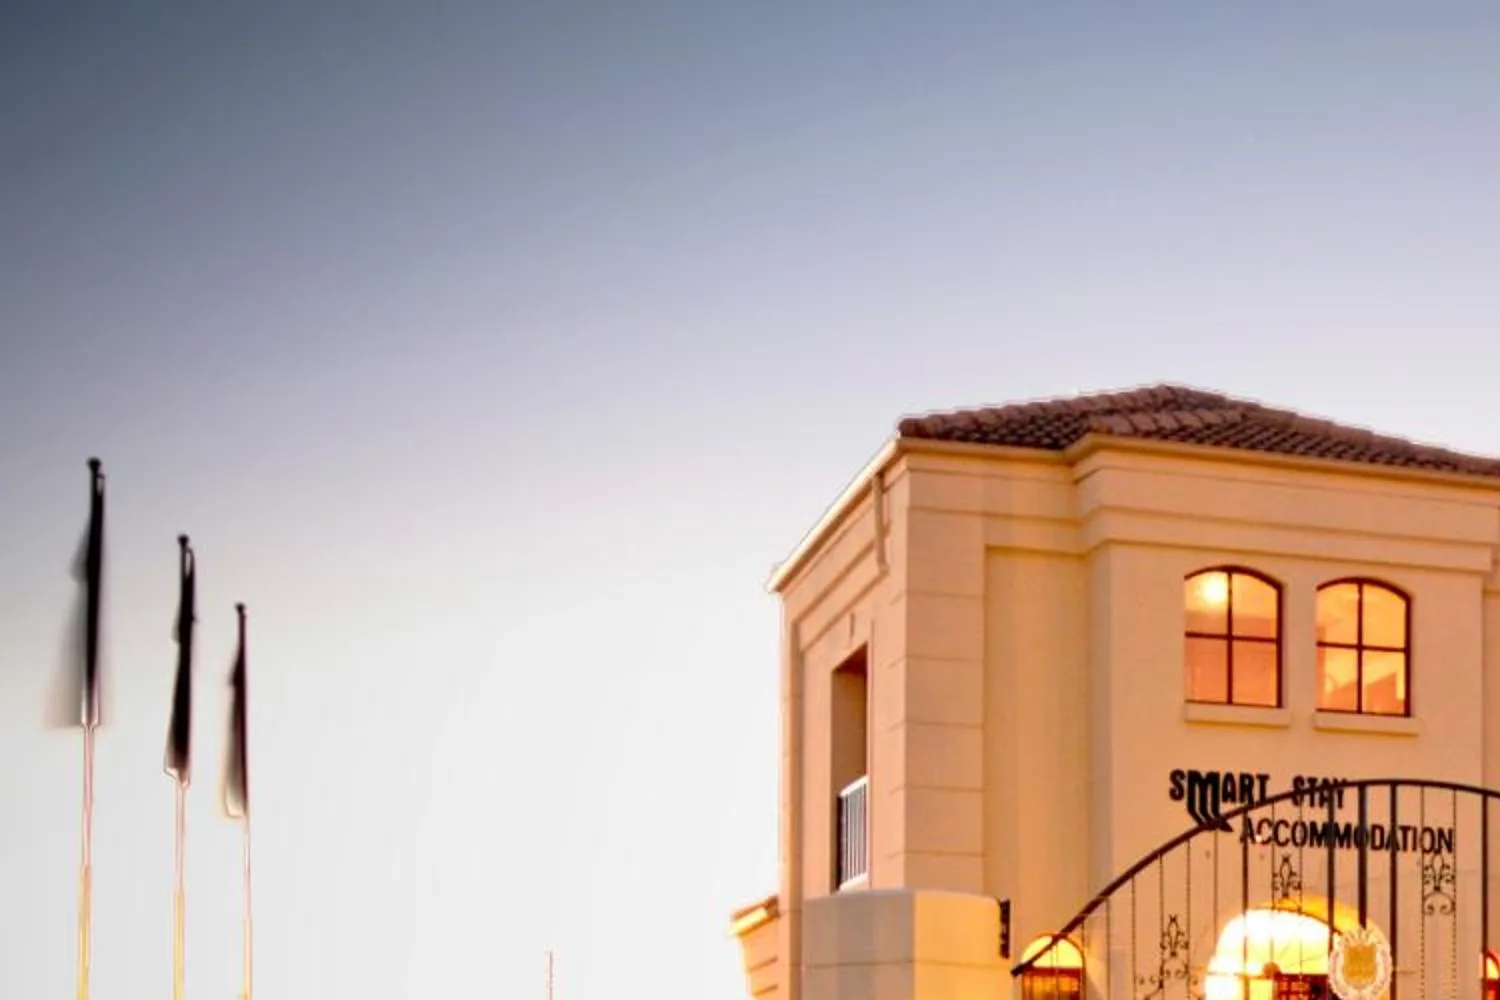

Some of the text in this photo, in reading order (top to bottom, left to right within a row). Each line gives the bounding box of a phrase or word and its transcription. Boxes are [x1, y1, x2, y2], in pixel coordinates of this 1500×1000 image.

[1169, 769, 1347, 832] SMART STAY
[1240, 817, 1453, 853] ACCOMMODATION
